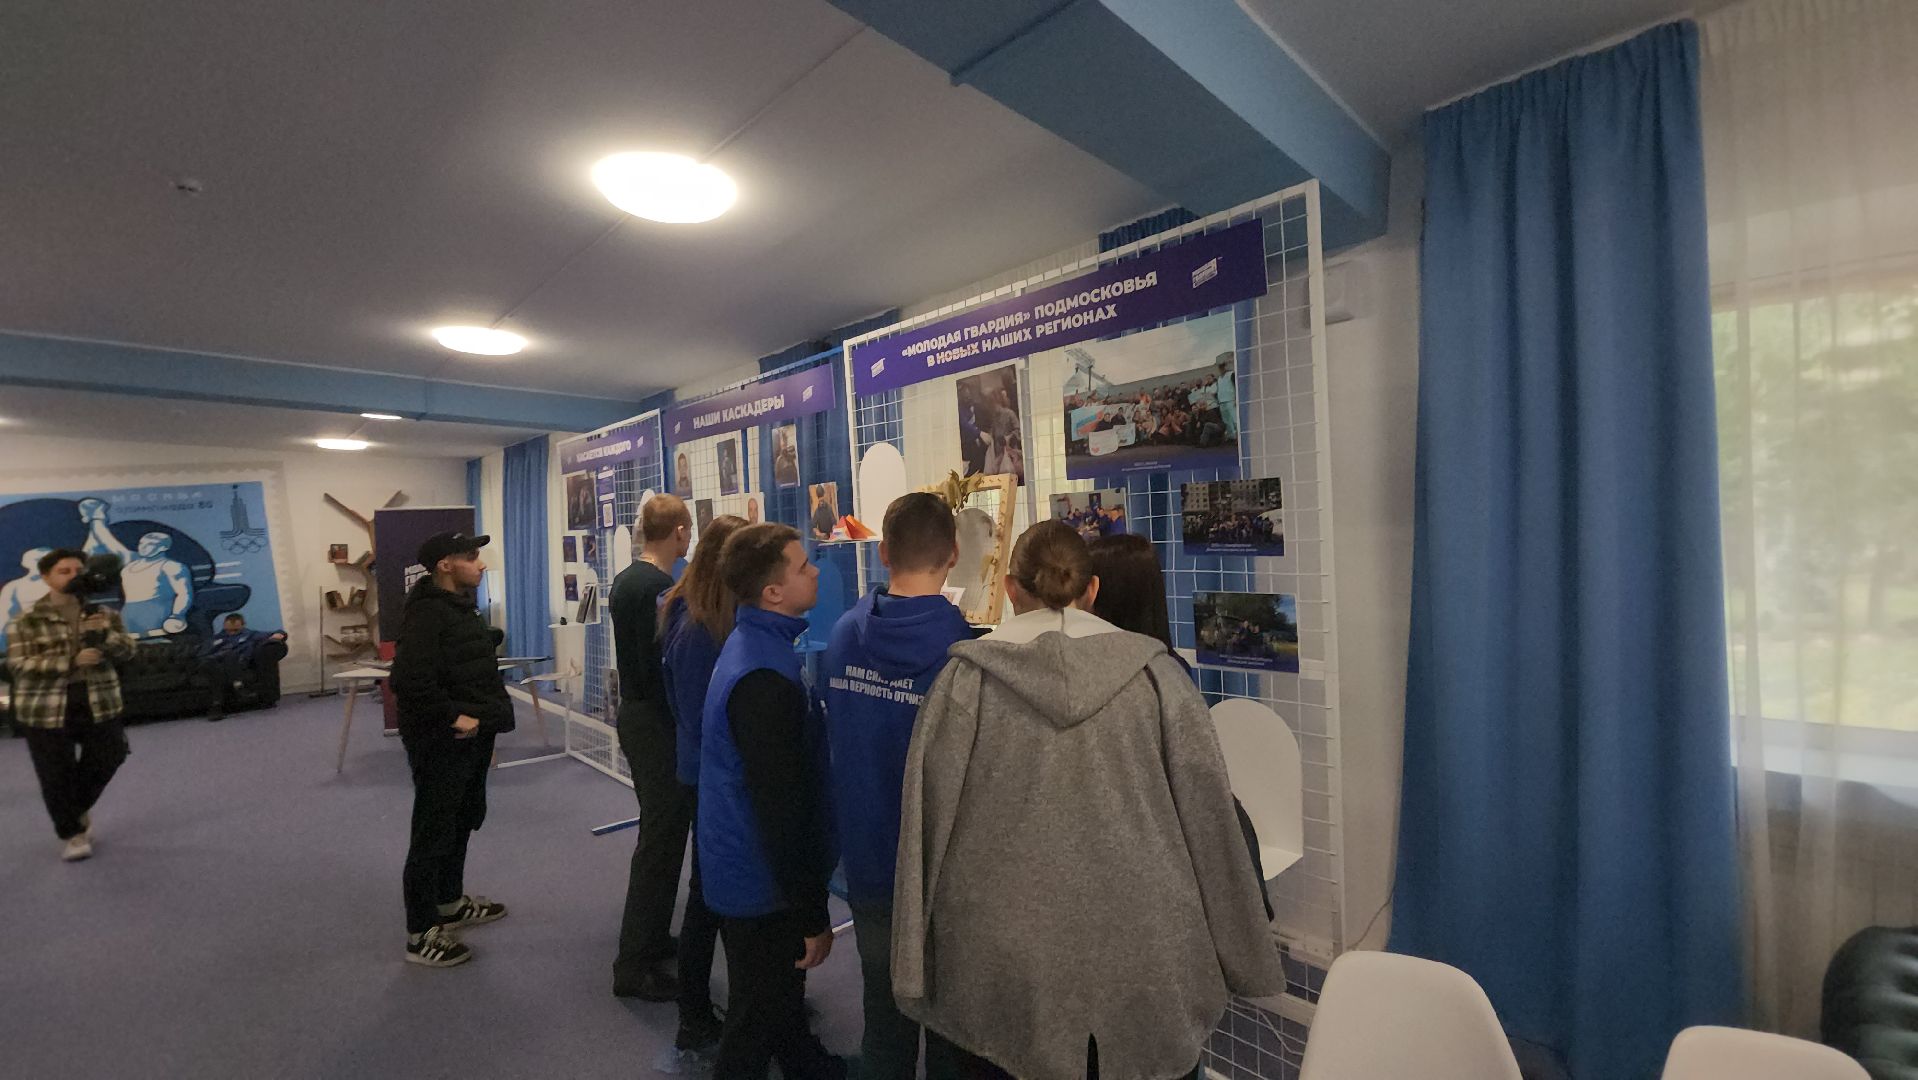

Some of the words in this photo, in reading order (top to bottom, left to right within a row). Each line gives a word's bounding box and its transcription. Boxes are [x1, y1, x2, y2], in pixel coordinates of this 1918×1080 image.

[964, 310, 1031, 341] ГВАРДИЯ»
[1034, 271, 1158, 320] ПОДМОСКОВЬЯ
[926, 355, 936, 368] В
[936, 342, 980, 365] НОВЫХ
[981, 329, 1033, 353] НАШИХ
[1036, 303, 1118, 338] РЕГИОНАХ
[693, 411, 721, 430] НАШИ
[722, 393, 785, 423] КАСКАДЕРЫ
[845, 665, 866, 680] НАМ
[849, 680, 893, 700] ВЕРНОСТЬ
